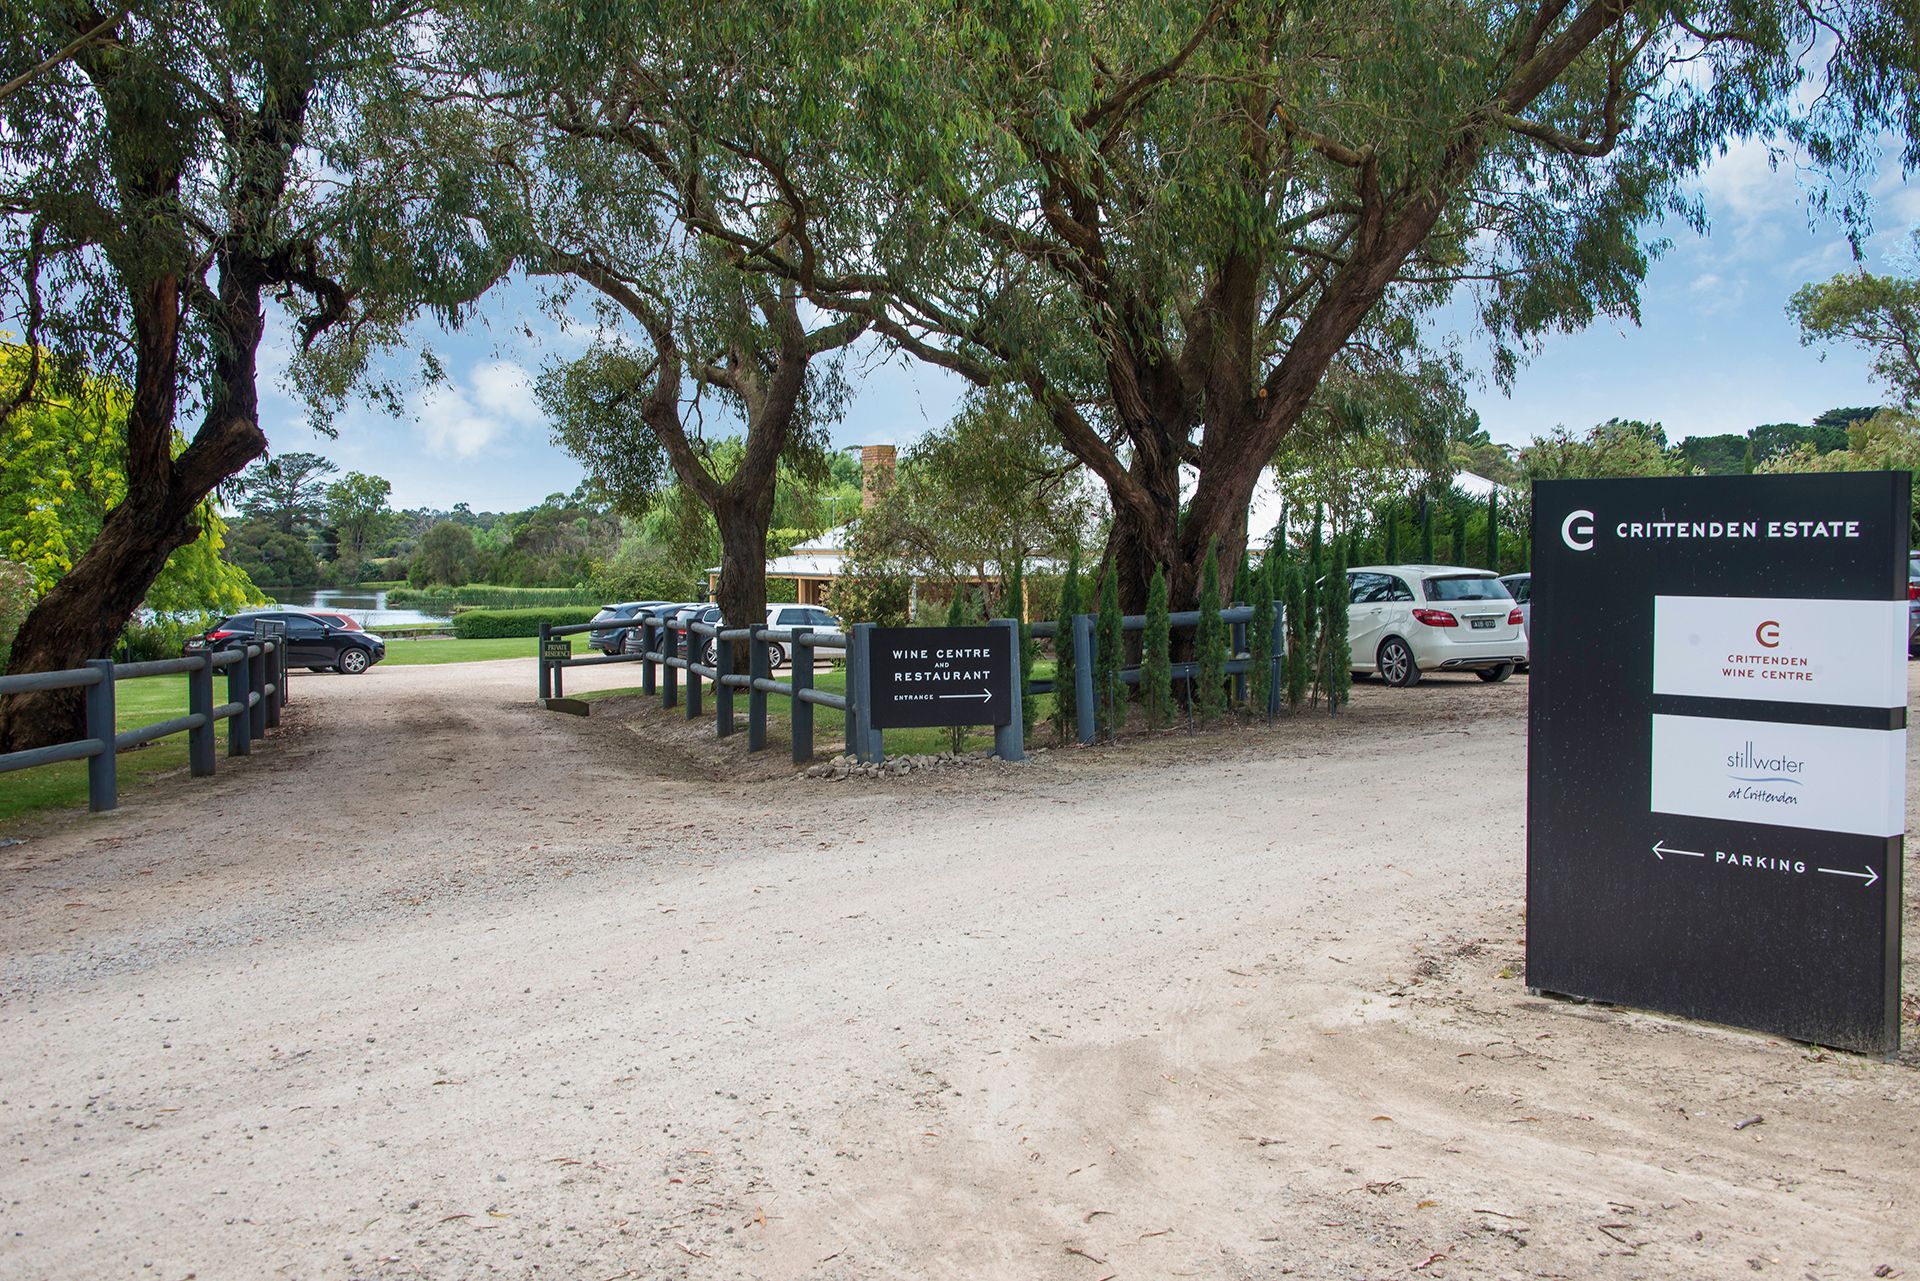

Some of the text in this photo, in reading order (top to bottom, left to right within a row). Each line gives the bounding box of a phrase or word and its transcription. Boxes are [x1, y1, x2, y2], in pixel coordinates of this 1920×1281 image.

[1616, 521, 1860, 538] CRITTENDEN ESTATE
[892, 649, 990, 659] WINE CENTRE
[1727, 654, 1808, 666] CRITTENDEN
[894, 670, 991, 682] RESTAURANT
[1722, 668, 1814, 681] WINE CENTRE
[1727, 741, 1804, 773] stillwater
[1727, 787, 1797, 804] at Crittenden
[1715, 851, 1806, 874] PARKING
